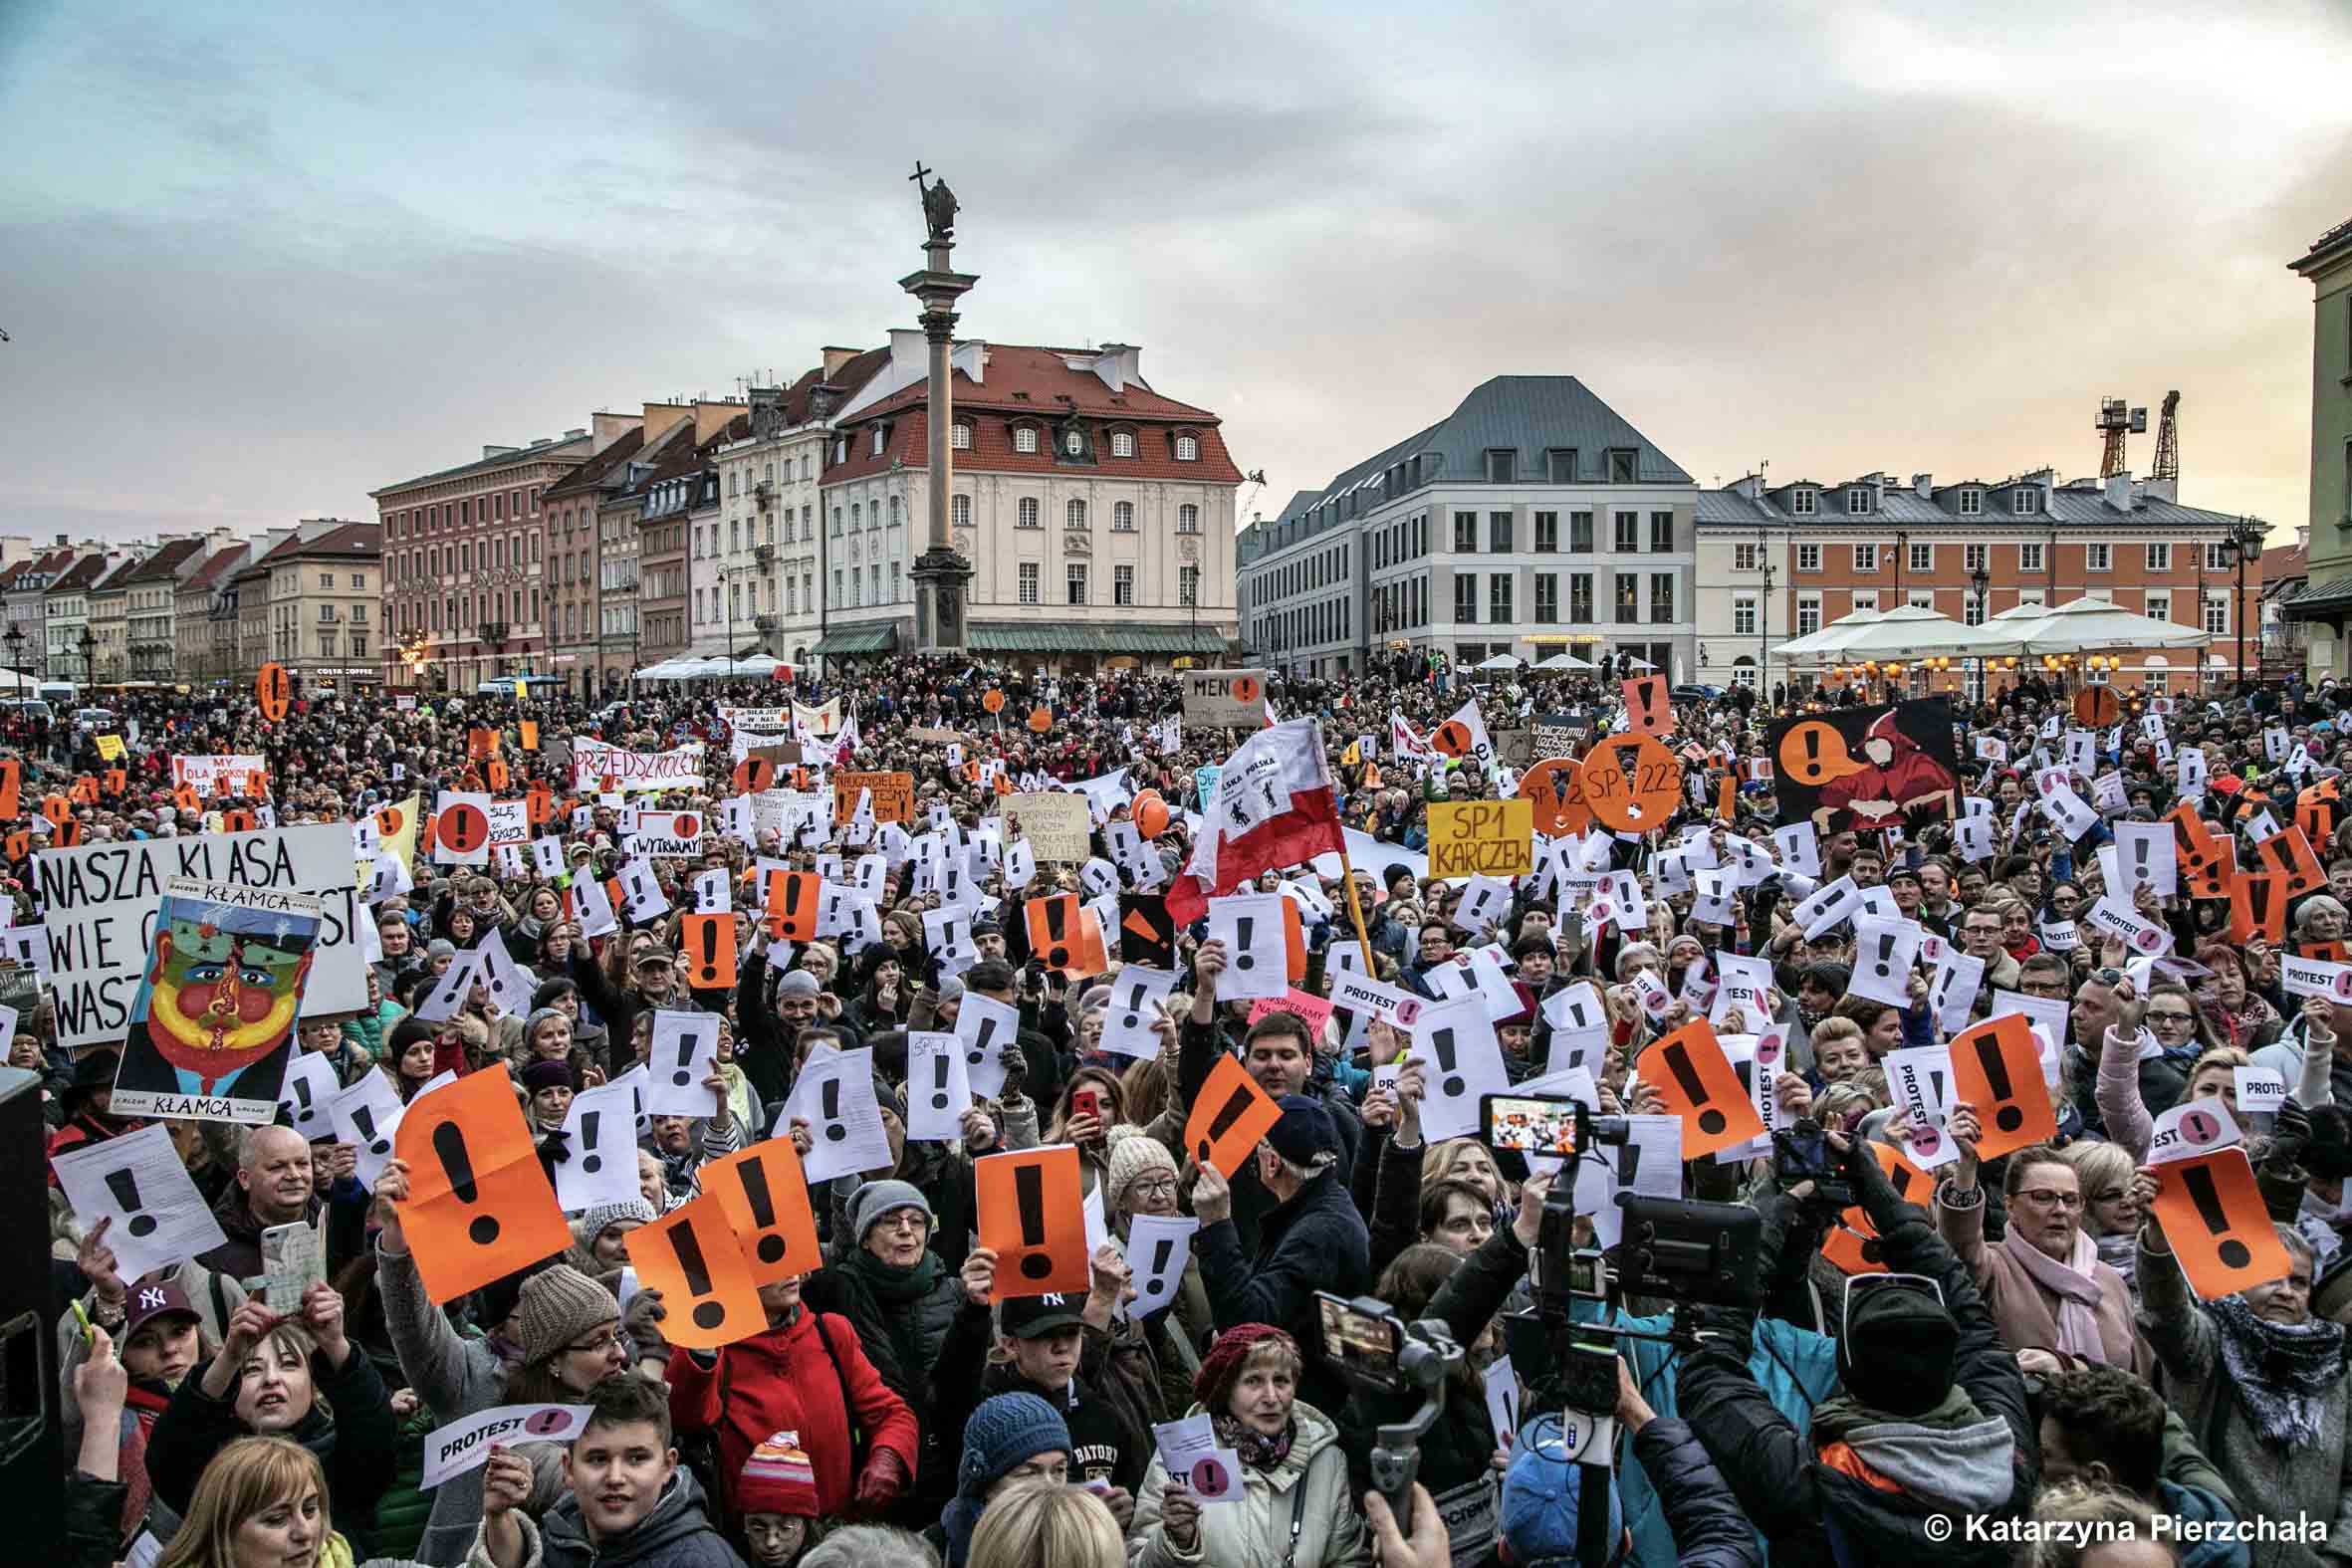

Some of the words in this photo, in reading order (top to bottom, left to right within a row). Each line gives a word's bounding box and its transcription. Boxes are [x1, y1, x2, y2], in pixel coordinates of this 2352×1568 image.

[1194, 678, 1230, 696] MEN
[1245, 757, 1275, 776] POLSKA
[1640, 763, 1683, 794] 223
[1436, 839, 1532, 873] KARCZEW
[39, 848, 160, 911] NASZA
[204, 884, 291, 911] KŁAMCA
[2099, 909, 2140, 936] PROTEST
[46, 917, 120, 973] WIE
[2287, 968, 2335, 987] PROTEST
[51, 973, 141, 1038] WAS
[1344, 984, 1398, 1010] PROTEST
[153, 1096, 232, 1117] KŁAMCA
[1900, 1063, 1929, 1126] PROTEST
[439, 1418, 526, 1462] PROTEST
